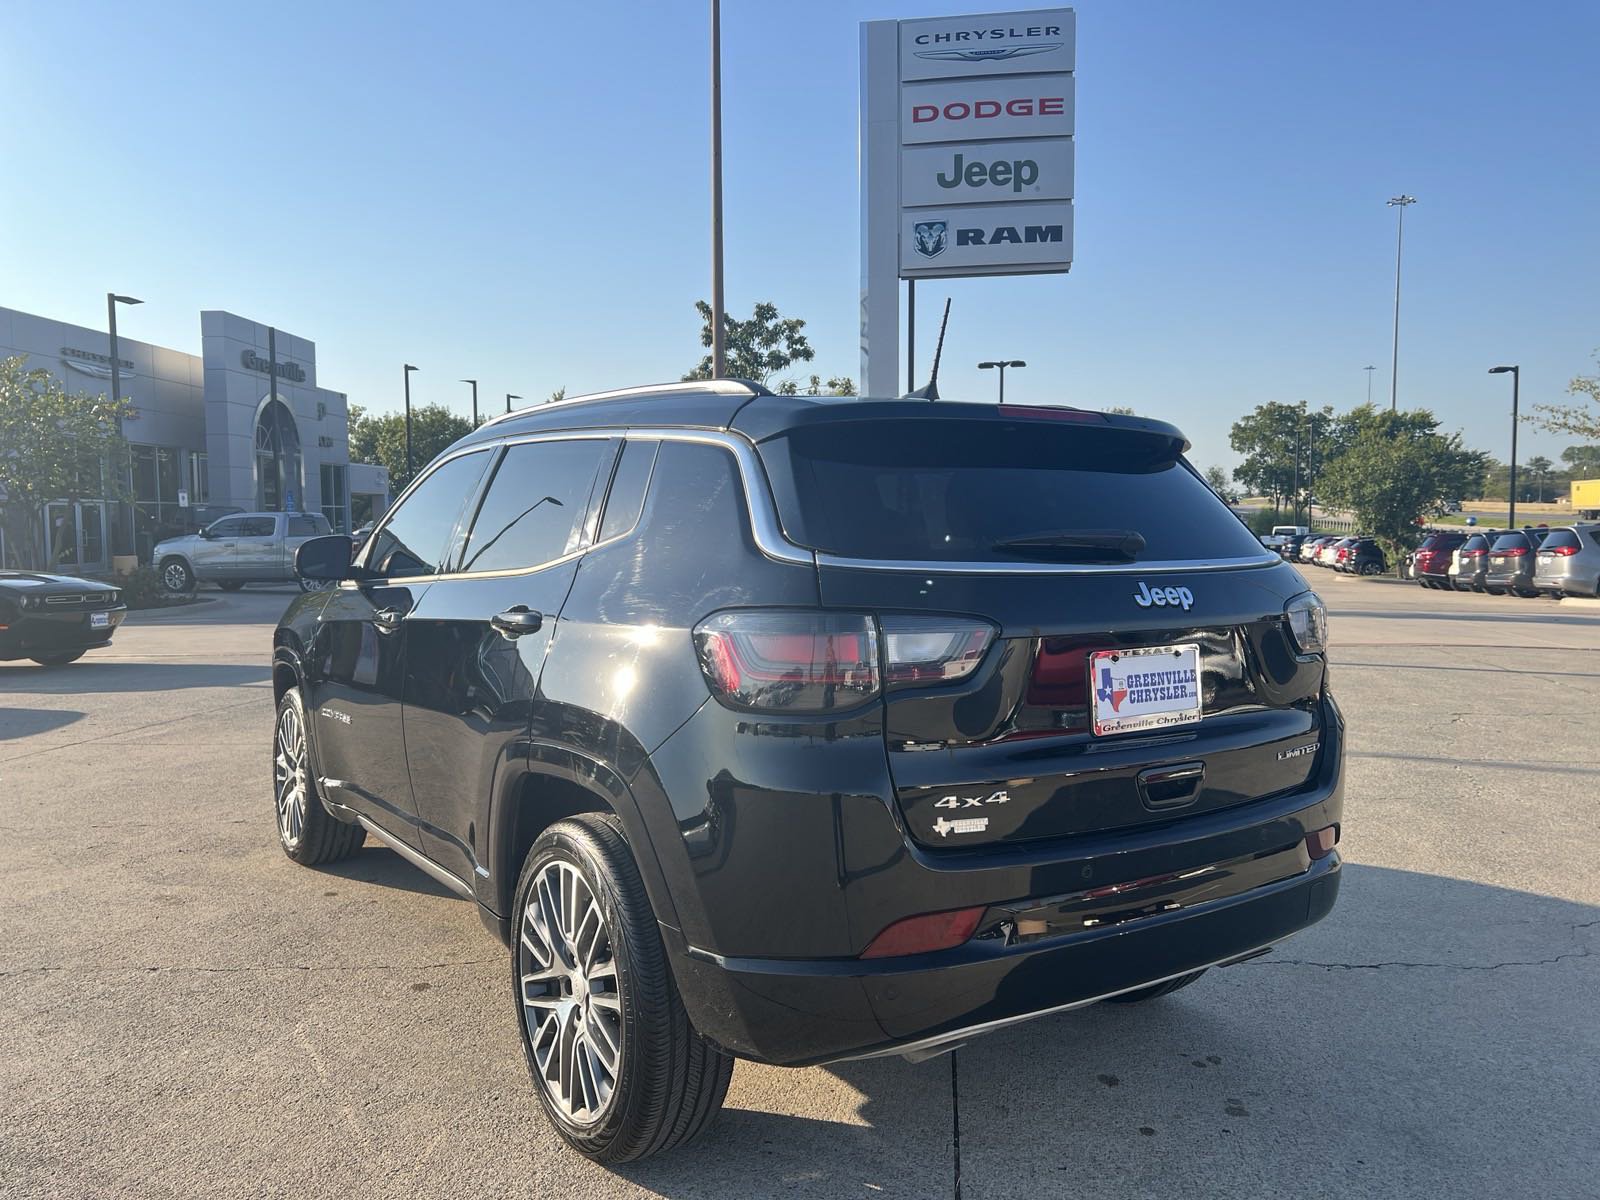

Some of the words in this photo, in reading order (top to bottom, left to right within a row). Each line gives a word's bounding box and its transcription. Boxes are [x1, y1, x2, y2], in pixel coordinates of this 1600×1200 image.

[915, 26, 1061, 45] CHRYSLER
[912, 97, 1064, 123] DODGE
[936, 153, 1039, 192] Jeep
[956, 225, 1063, 246] RAM
[1134, 581, 1194, 610] Jeep
[1121, 646, 1173, 657] TEXAS
[1126, 668, 1197, 689] GREENVILLE
[1103, 720, 1154, 732] Greenville
[1156, 713, 1197, 726] Chrysler
[1276, 742, 1320, 760] LIMITED
